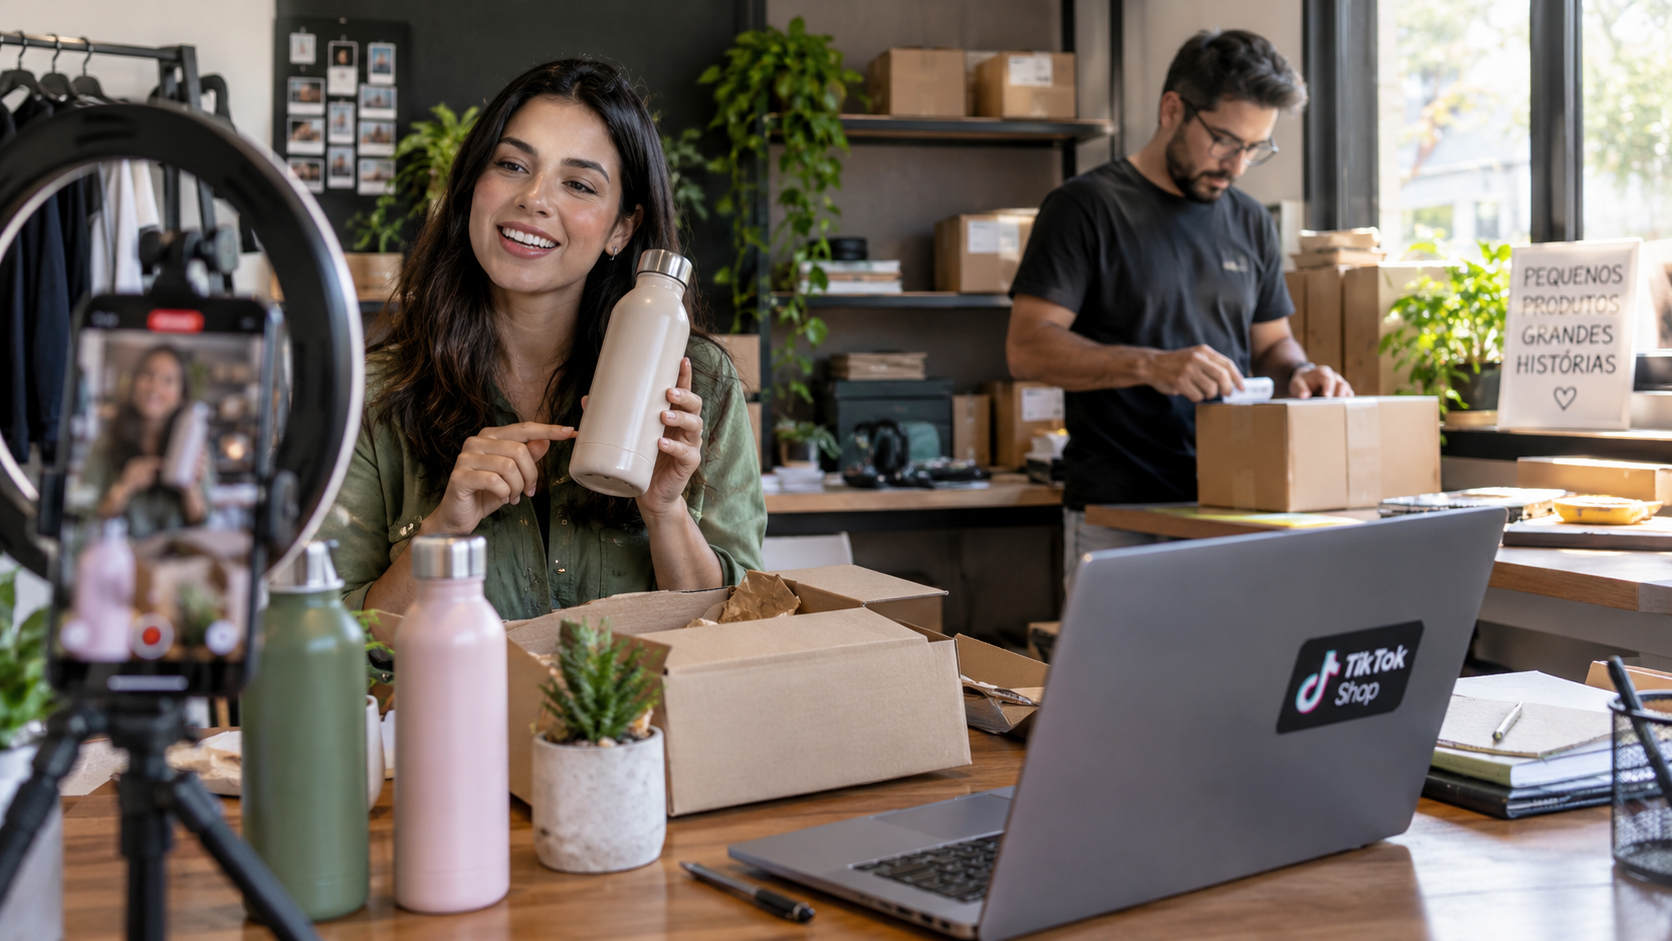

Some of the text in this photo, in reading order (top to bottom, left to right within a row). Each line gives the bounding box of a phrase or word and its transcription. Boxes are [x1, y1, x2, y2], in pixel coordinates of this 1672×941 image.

[1525, 265, 1623, 287] PEQUENOS
[1523, 295, 1620, 315] PRODUTOS
[1523, 325, 1613, 345] GRANDES
[1517, 350, 1616, 374] HISTÓRIAS
[1344, 644, 1408, 679] TikTok
[1335, 681, 1380, 706] Shop
